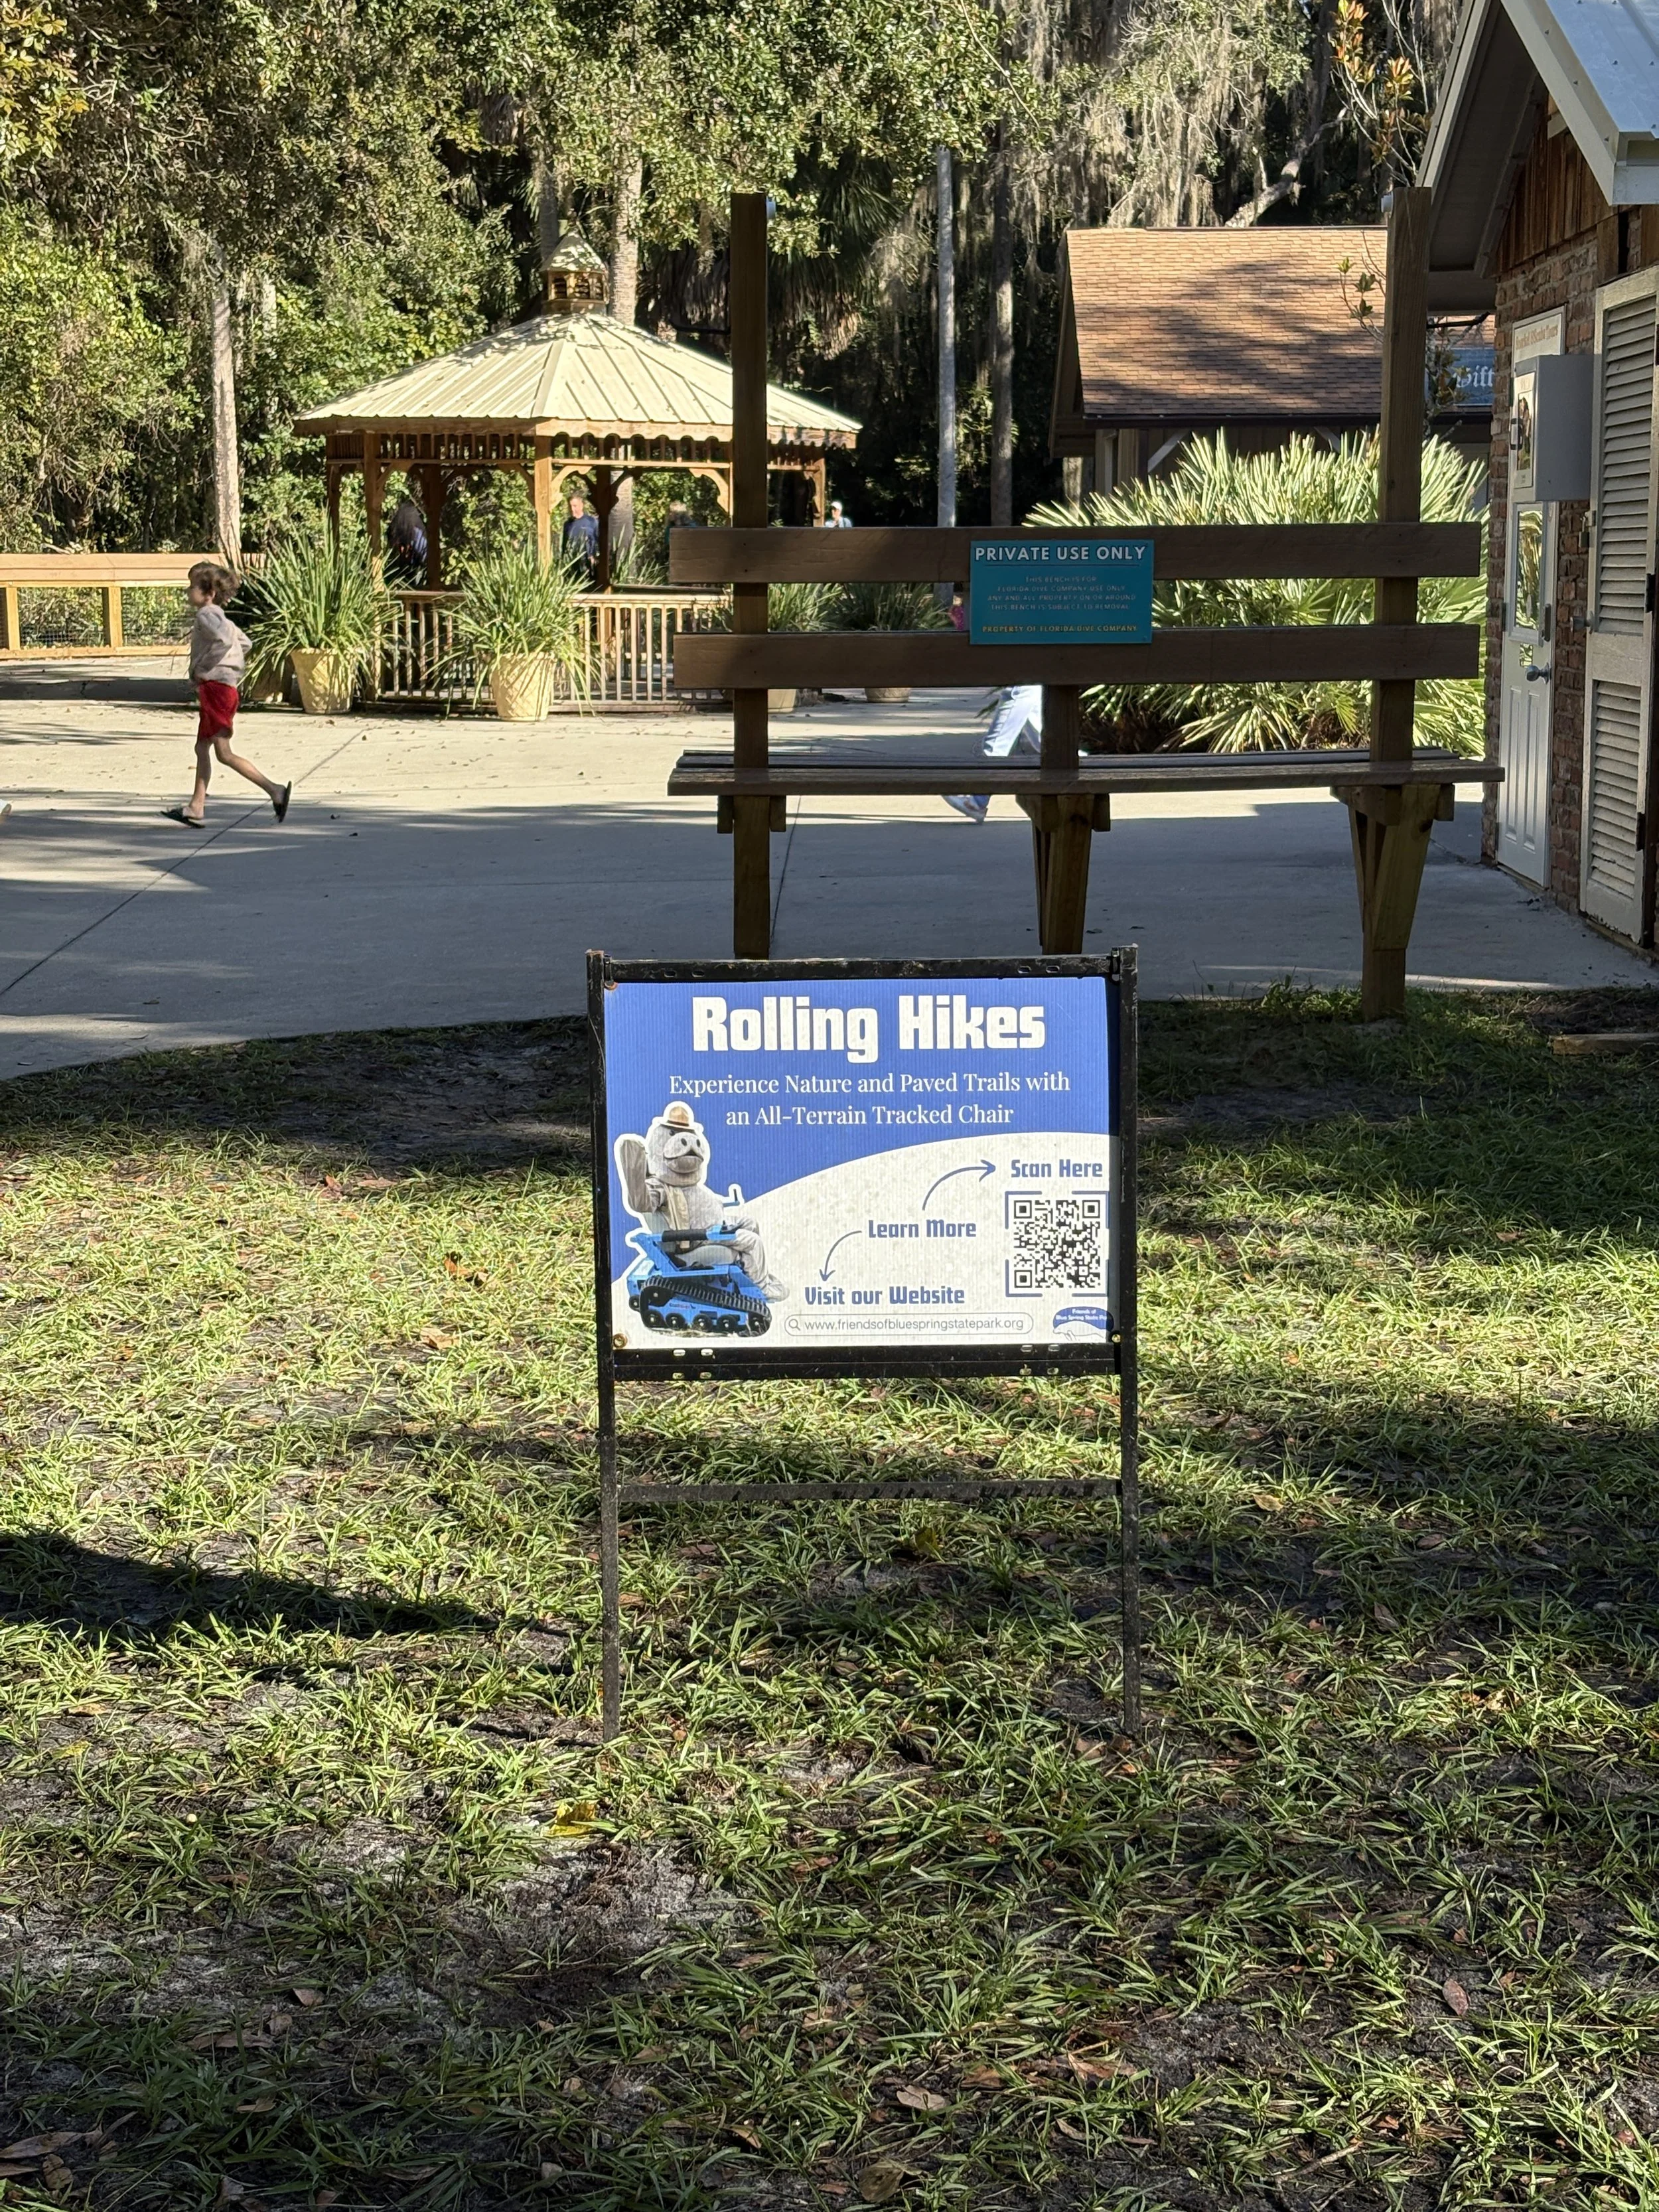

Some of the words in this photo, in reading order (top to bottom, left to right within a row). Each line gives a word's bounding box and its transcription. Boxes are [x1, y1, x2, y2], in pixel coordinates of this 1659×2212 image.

[975, 547, 1049, 561] PRIVATE
[1056, 546, 1089, 560] USE
[1096, 546, 1145, 560] ONLY
[692, 996, 878, 1063] Rolling
[898, 995, 1045, 1050] Hikes
[670, 1074, 779, 1098] Experience
[785, 1074, 852, 1093] Nature
[857, 1072, 893, 1093] and
[900, 1071, 958, 1092] Paved
[964, 1072, 1021, 1092] Trails
[1025, 1070, 1070, 1091] with
[726, 1108, 749, 1126] an
[755, 1105, 867, 1126] All-Terrain
[872, 1104, 953, 1124] Tracked
[958, 1104, 1014, 1124] Chair
[1011, 1159, 1052, 1178] Scan
[1059, 1159, 1104, 1177] Here
[868, 1220, 919, 1238] Learn
[926, 1219, 977, 1237] More
[805, 1286, 845, 1305] Visit
[851, 1290, 883, 1305] our
[889, 1286, 965, 1304] Website
[804, 1318, 1024, 1331] www.friendsofbluespringstatepark.org
